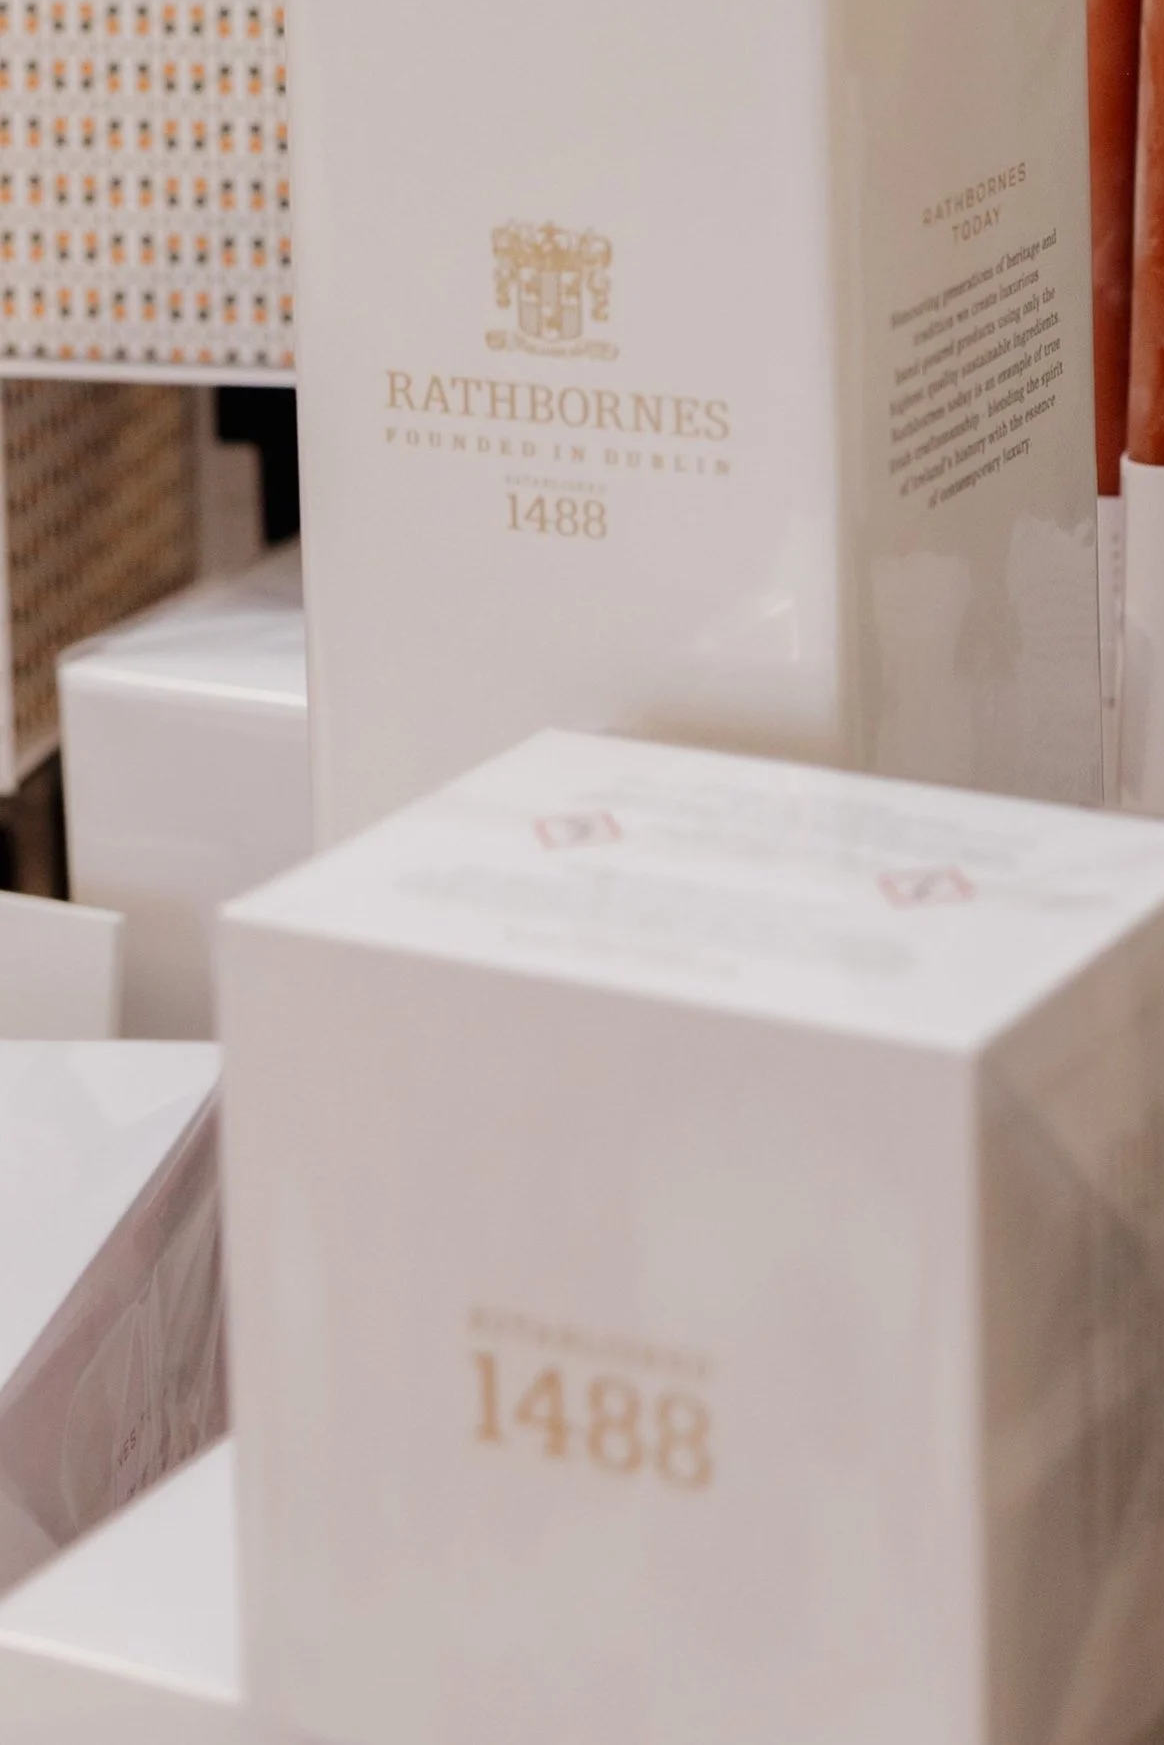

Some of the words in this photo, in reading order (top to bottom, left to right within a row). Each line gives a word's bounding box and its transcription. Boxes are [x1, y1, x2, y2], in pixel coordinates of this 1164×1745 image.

[922, 162, 1027, 227] RATHBORNES
[952, 204, 1001, 244] TODAY
[996, 255, 1005, 275] of
[1006, 241, 1040, 270] heritage
[1042, 227, 1057, 250] and
[999, 268, 1039, 301] luxurious
[957, 321, 995, 355] products
[998, 307, 1021, 330] using
[1022, 294, 1040, 316] only
[1042, 286, 1056, 303] the
[962, 338, 1011, 378] sustainable
[974, 383, 982, 399] is
[984, 377, 996, 392] an
[997, 352, 1032, 384] example
[1033, 343, 1042, 363] of
[1043, 337, 1061, 357] true
[385, 368, 731, 442] RATHBORNES
[987, 387, 1025, 418] blending
[1026, 375, 1040, 395] the
[1041, 360, 1064, 388] spirit
[988, 421, 1008, 444] with
[1009, 414, 1023, 432] the
[1024, 394, 1056, 423] essence
[385, 426, 537, 458] FOUNDED
[553, 439, 585, 463] IN
[605, 449, 731, 476] DUBLIN
[505, 492, 607, 540] 1488
[474, 1349, 714, 1494] 1488
